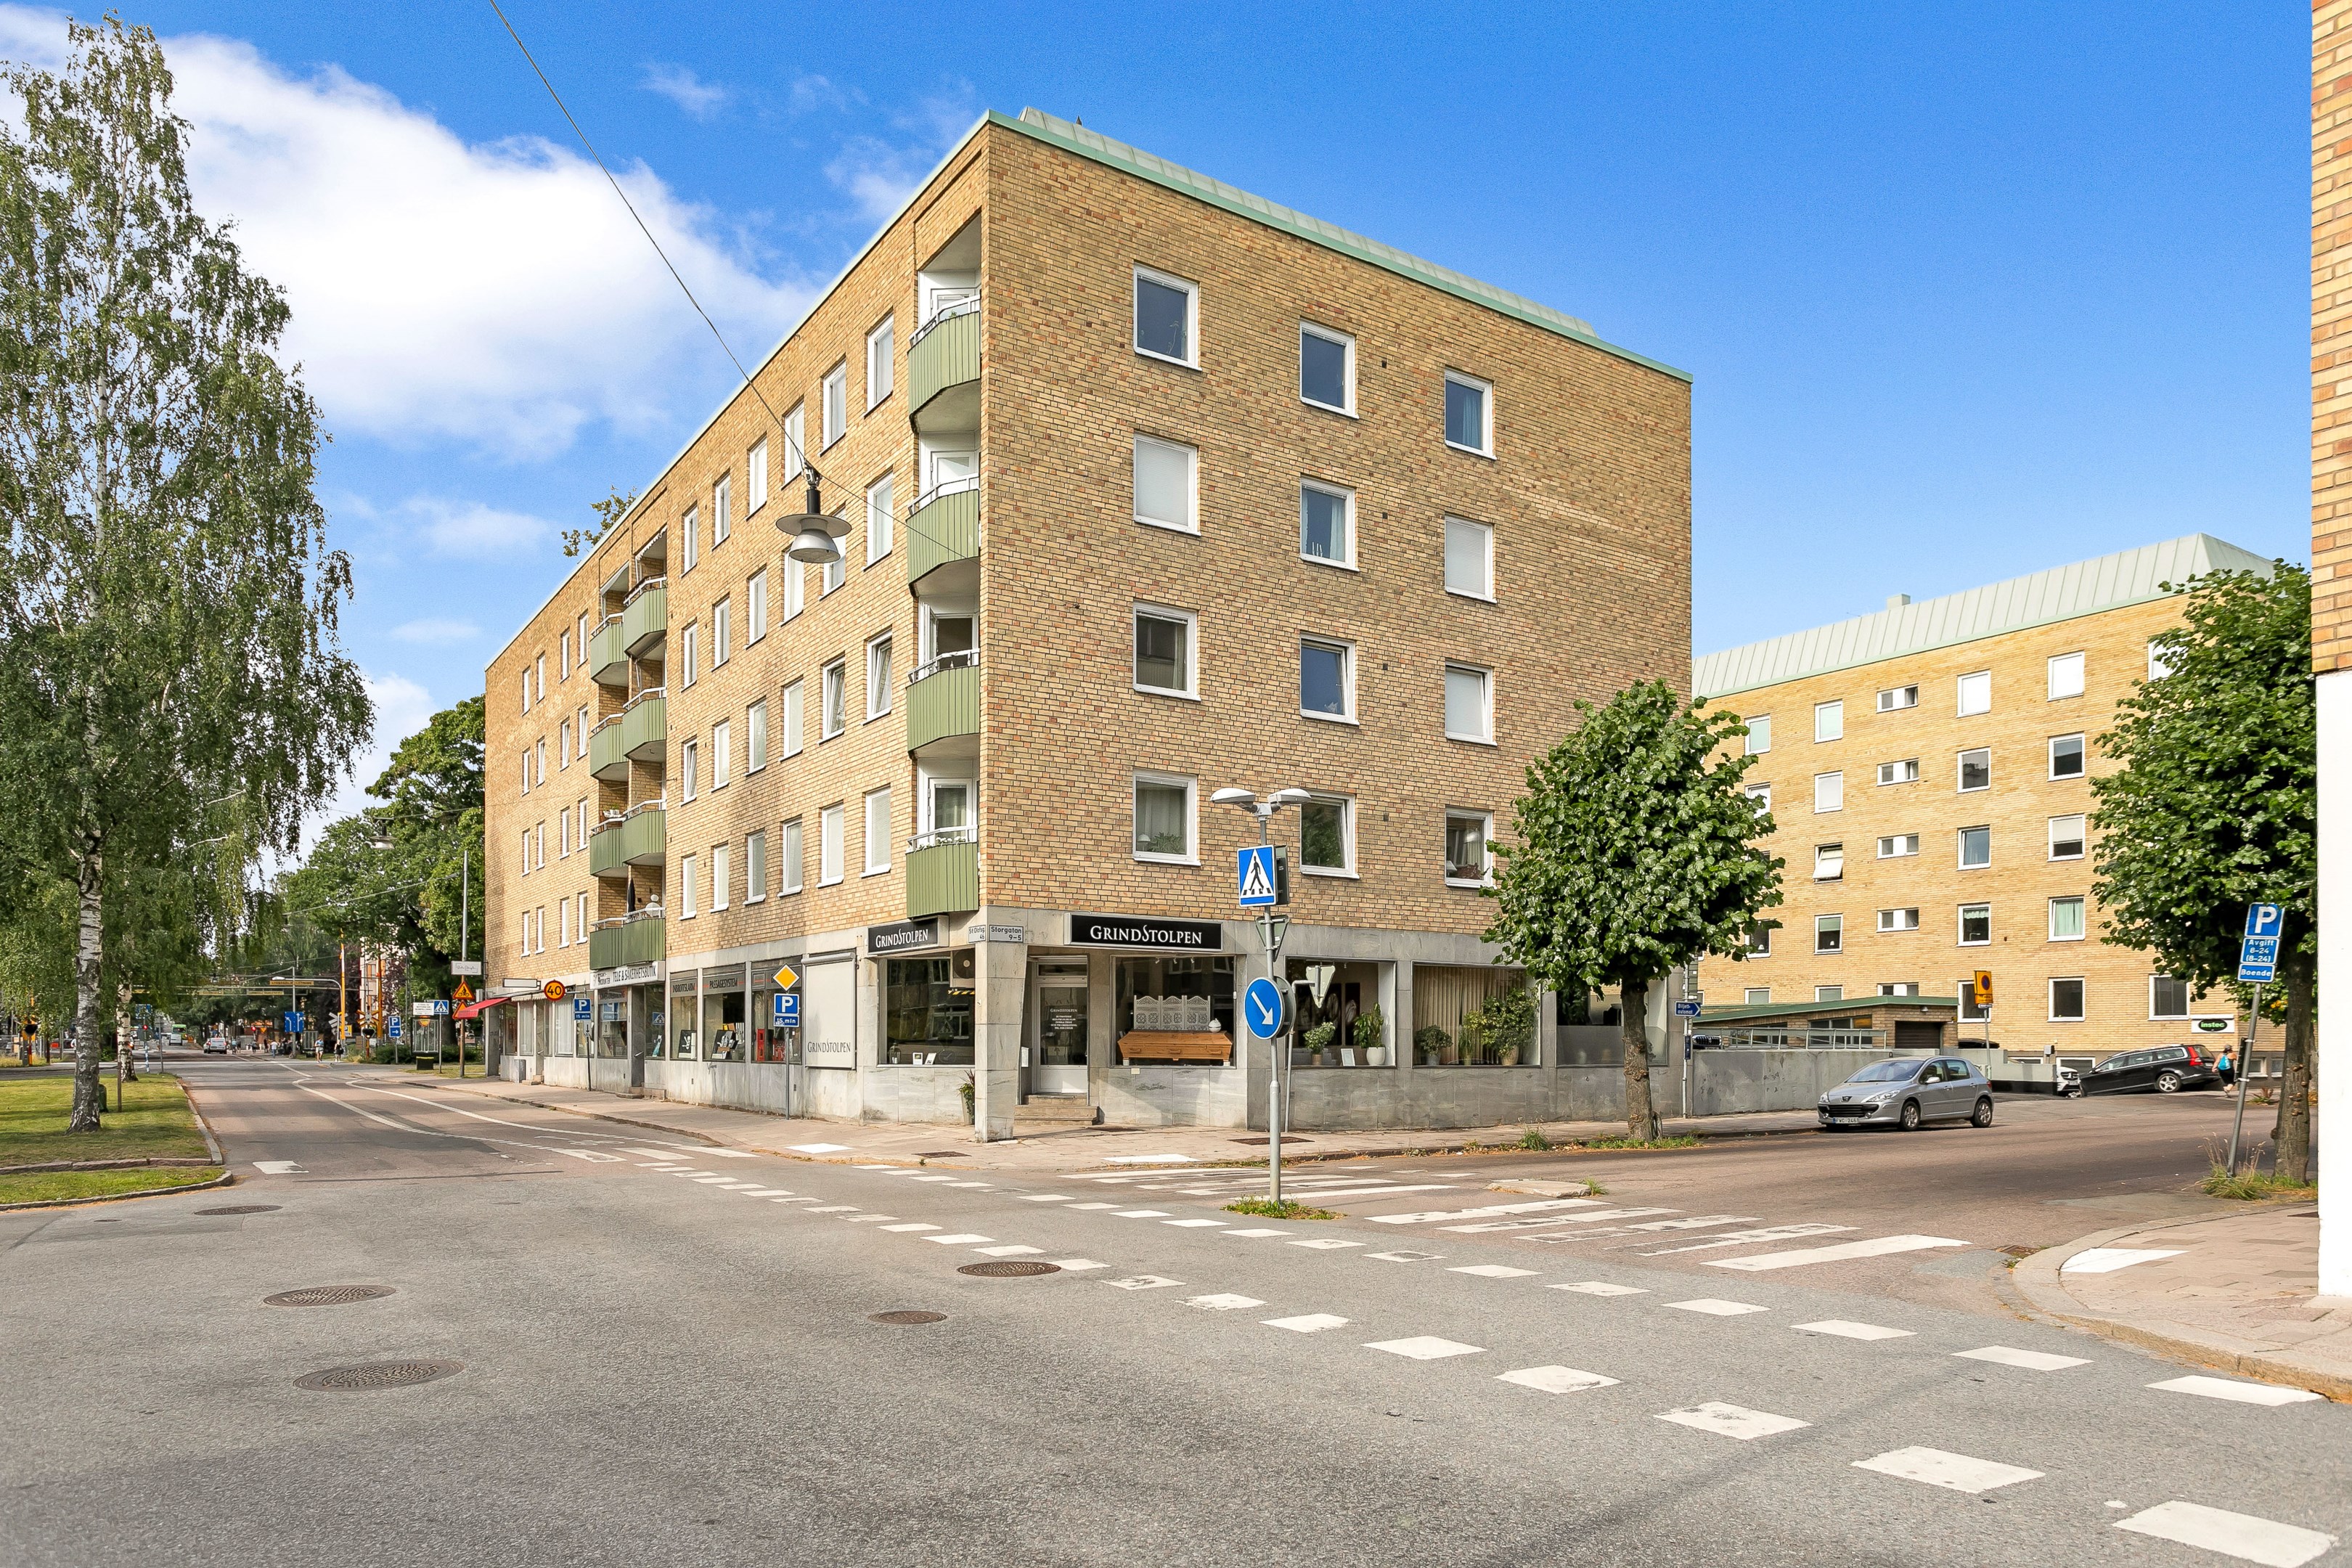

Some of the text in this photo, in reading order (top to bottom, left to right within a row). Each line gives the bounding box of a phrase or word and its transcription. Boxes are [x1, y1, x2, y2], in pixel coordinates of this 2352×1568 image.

[2254, 906, 2278, 934] P
[875, 928, 928, 948] GRINDSTOLPEN
[1090, 924, 1202, 944] GRINDSTOLPEN
[613, 969, 621, 982] TELE
[709, 977, 738, 989] PASSAGESYSTEM
[547, 985, 562, 996] 40
[579, 1000, 587, 1011] P
[781, 996, 793, 1013] P
[392, 1017, 399, 1026] P
[807, 1038, 851, 1053] GRINDSTOLPEN
